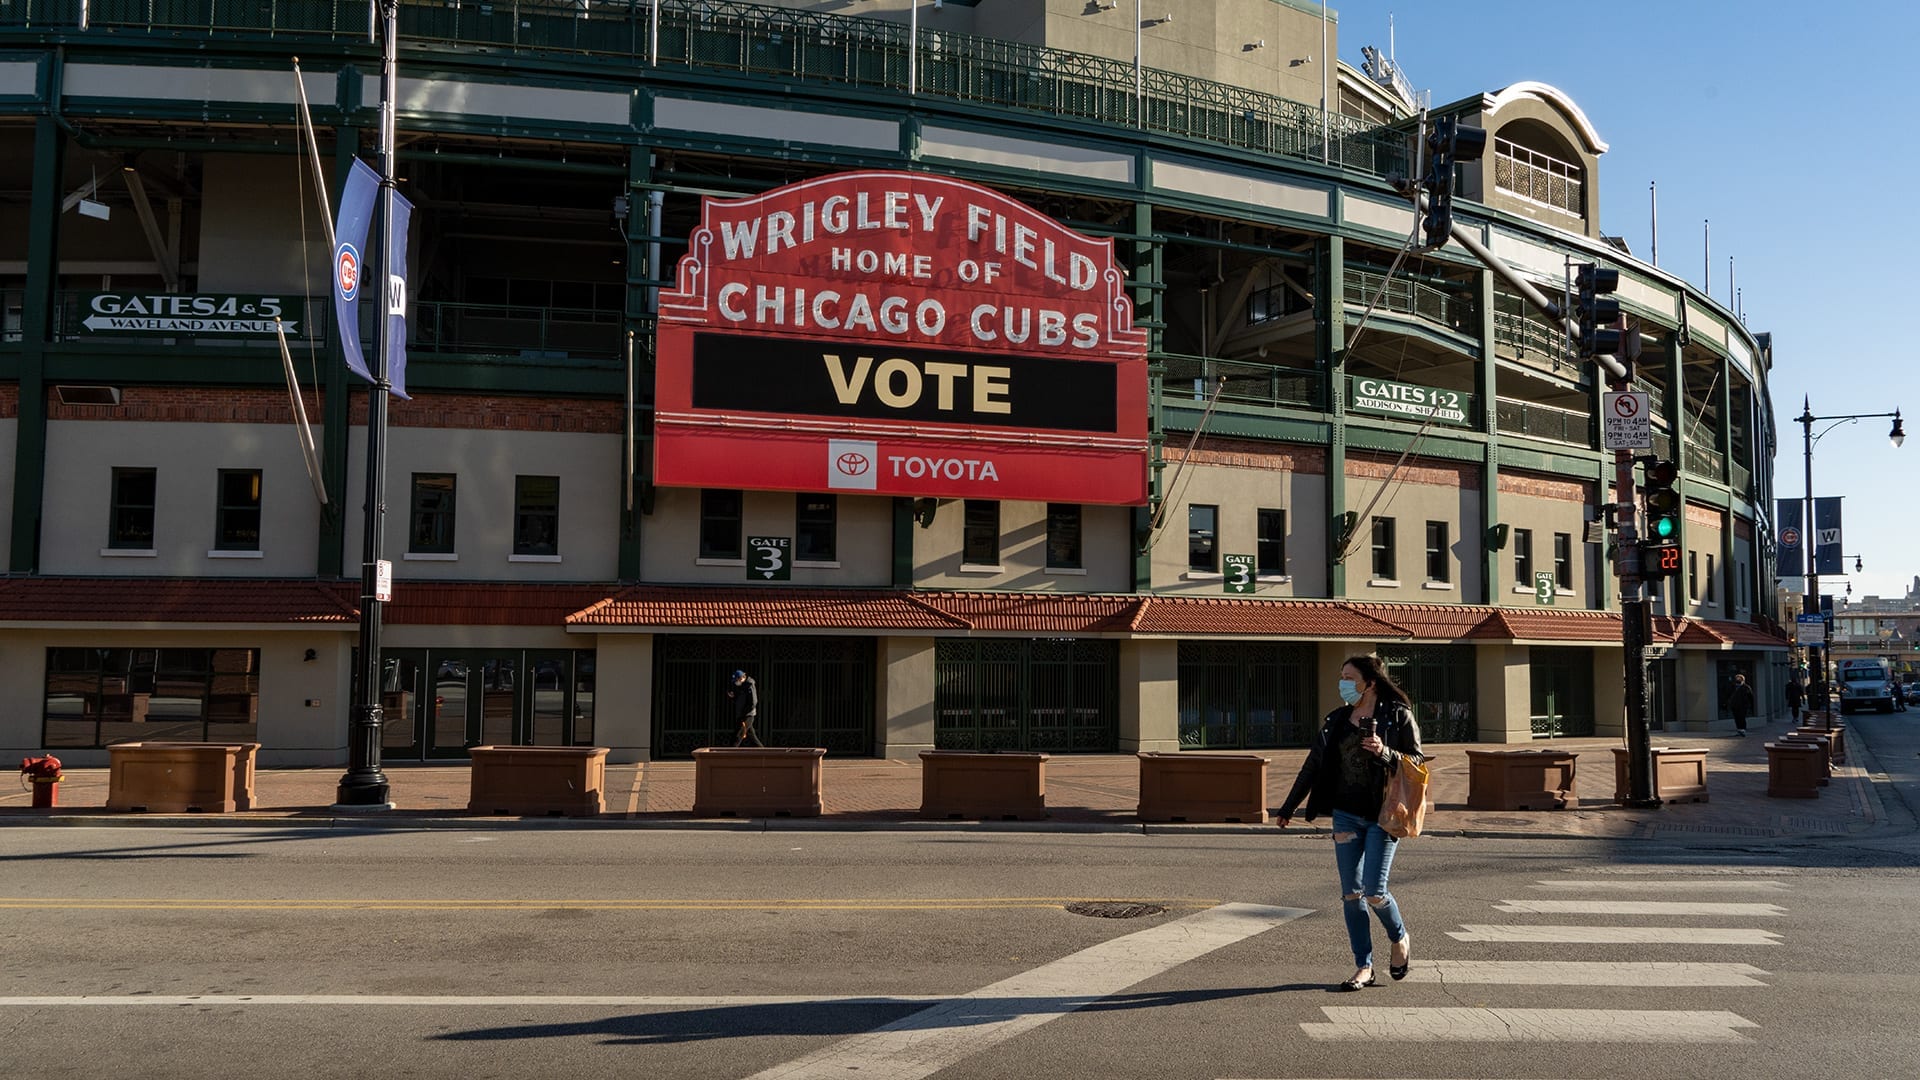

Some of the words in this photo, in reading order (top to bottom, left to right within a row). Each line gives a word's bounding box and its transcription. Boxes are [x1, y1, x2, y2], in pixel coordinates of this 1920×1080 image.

[720, 191, 943, 260] WRIGLEY
[968, 203, 1098, 291] FIELD
[832, 247, 932, 279] HOME
[958, 259, 1002, 285] OF
[390, 281, 402, 308] W
[110, 318, 204, 330] WAVELAND
[208, 319, 273, 332] AVENUE
[719, 282, 945, 336] CHICAGO
[971, 304, 1099, 349] CUBS
[823, 354, 1012, 415] VOTE
[1360, 380, 1425, 403] GATES
[1360, 399, 1402, 411] ADDISON
[888, 456, 999, 482] TOYOTA
[750, 538, 789, 547] GATE
[1822, 530, 1836, 543] W
[755, 546, 783, 571] 3
[1226, 555, 1253, 563] GATE
[1661, 549, 1678, 569] 22
[1230, 563, 1249, 584] 3
[1539, 579, 1551, 597] 3
